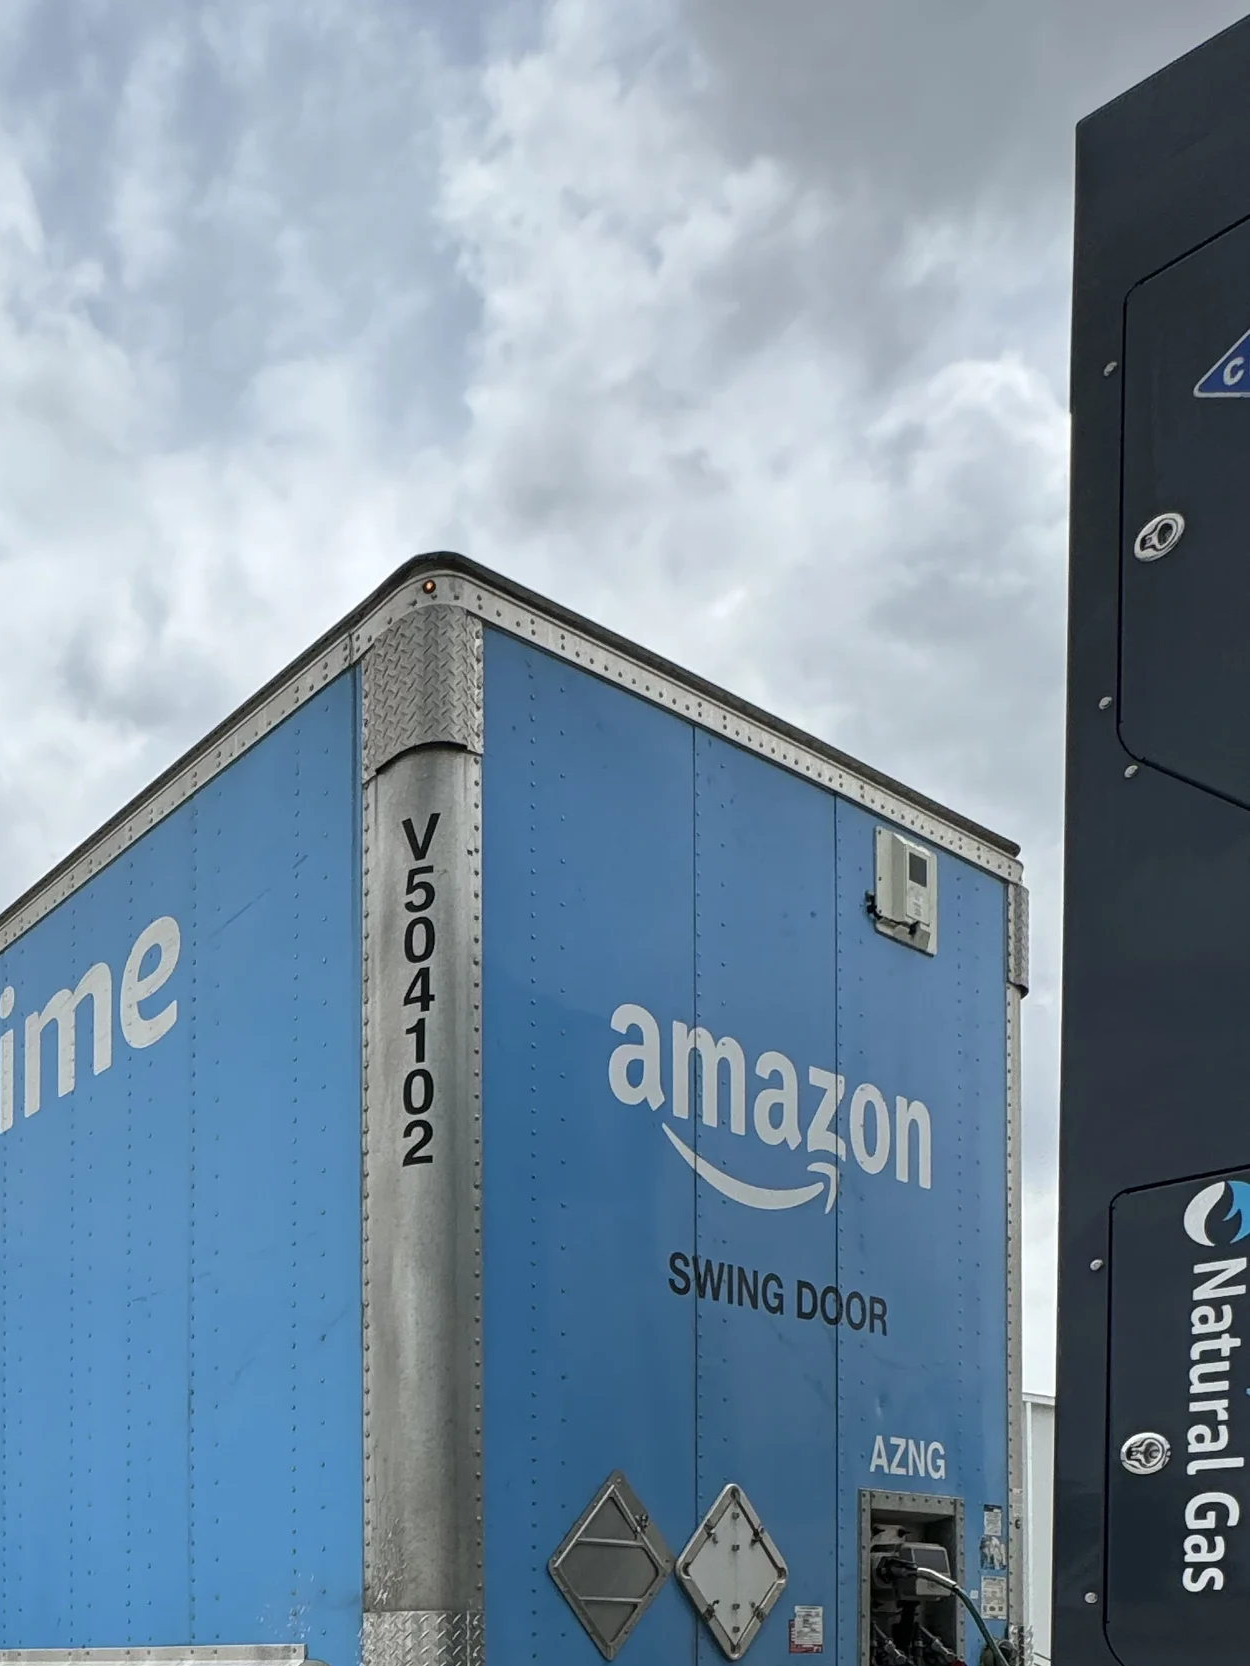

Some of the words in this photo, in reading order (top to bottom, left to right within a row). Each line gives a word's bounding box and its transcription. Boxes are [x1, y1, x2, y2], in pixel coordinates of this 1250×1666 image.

[1223, 356, 1244, 385] C
[401, 812, 441, 1168] V504102
[608, 1003, 932, 1190] amazon
[668, 1251, 784, 1316] SWING
[796, 1279, 888, 1337] DOOR
[1186, 1257, 1248, 1476] Natural
[869, 1435, 946, 1480] AZNG
[1182, 1490, 1241, 1594] Gas
